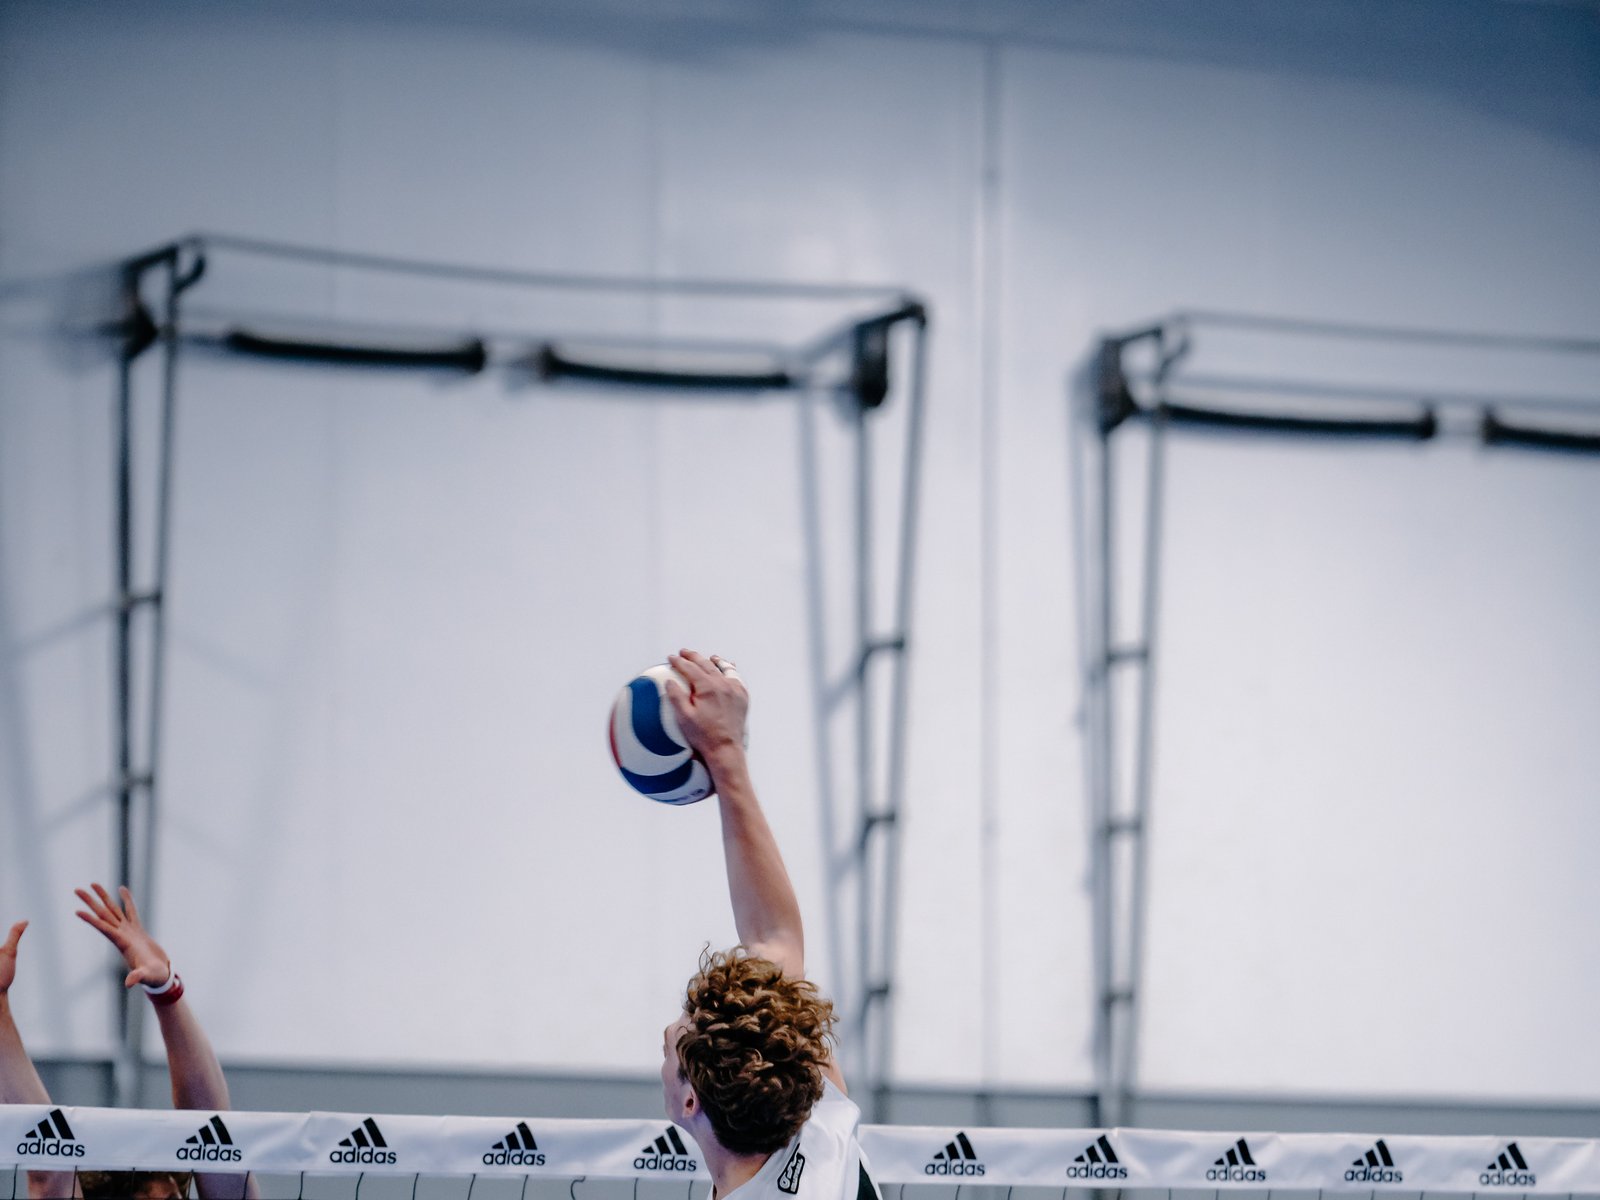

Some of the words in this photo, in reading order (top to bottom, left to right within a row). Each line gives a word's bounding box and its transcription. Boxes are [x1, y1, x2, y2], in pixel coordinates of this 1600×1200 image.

[17, 1138, 85, 1157] adidas
[176, 1144, 242, 1162] adidas
[329, 1147, 397, 1164] adidas
[482, 1149, 546, 1166] adidas
[633, 1154, 697, 1172] adidas
[924, 1159, 985, 1176] adidas
[1066, 1162, 1128, 1179] adidas
[1206, 1165, 1267, 1182] adidas
[1344, 1166, 1403, 1183] adidas
[1479, 1169, 1536, 1186] adidas
